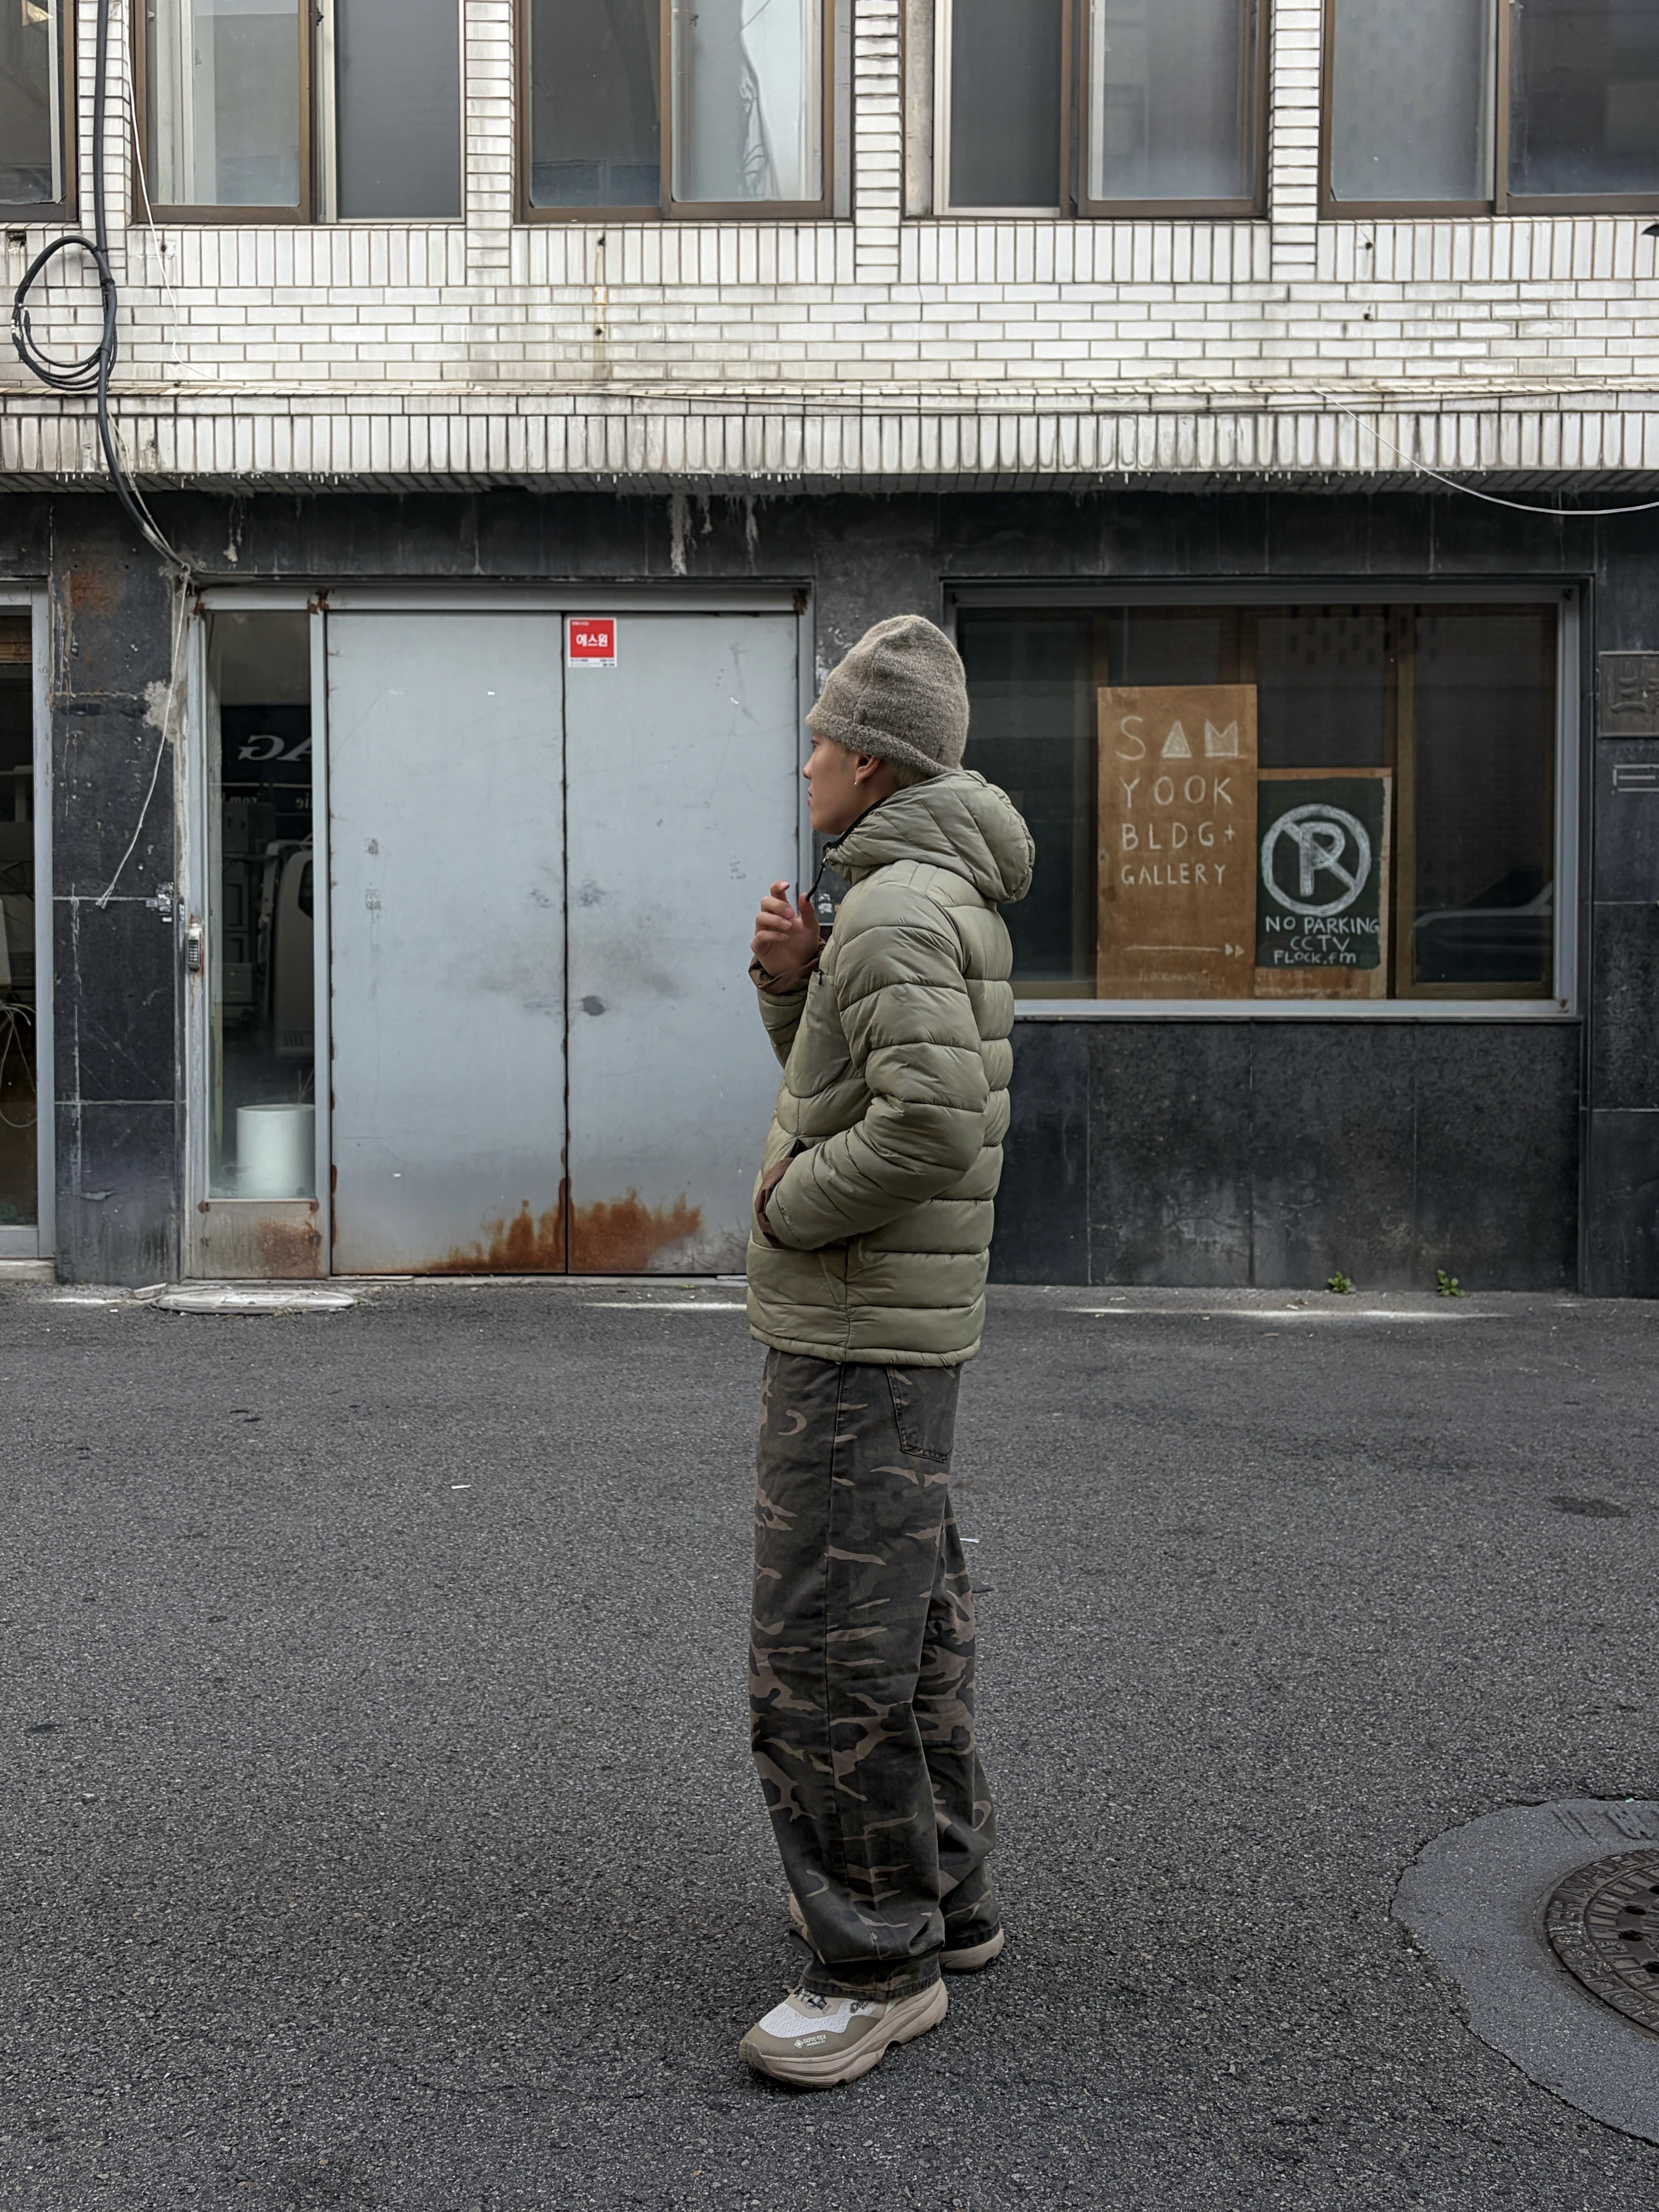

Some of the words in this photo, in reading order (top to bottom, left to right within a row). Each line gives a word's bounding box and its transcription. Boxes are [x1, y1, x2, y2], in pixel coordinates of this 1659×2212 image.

[576, 633, 608, 647] 에스원
[1115, 716, 1239, 761] SAM
[1120, 775, 1233, 808] YOOK
[1121, 863, 1226, 885] GALLERY
[1265, 916, 1296, 932] NO
[1304, 916, 1379, 935] PARKING
[1290, 934, 1350, 952] CCTV
